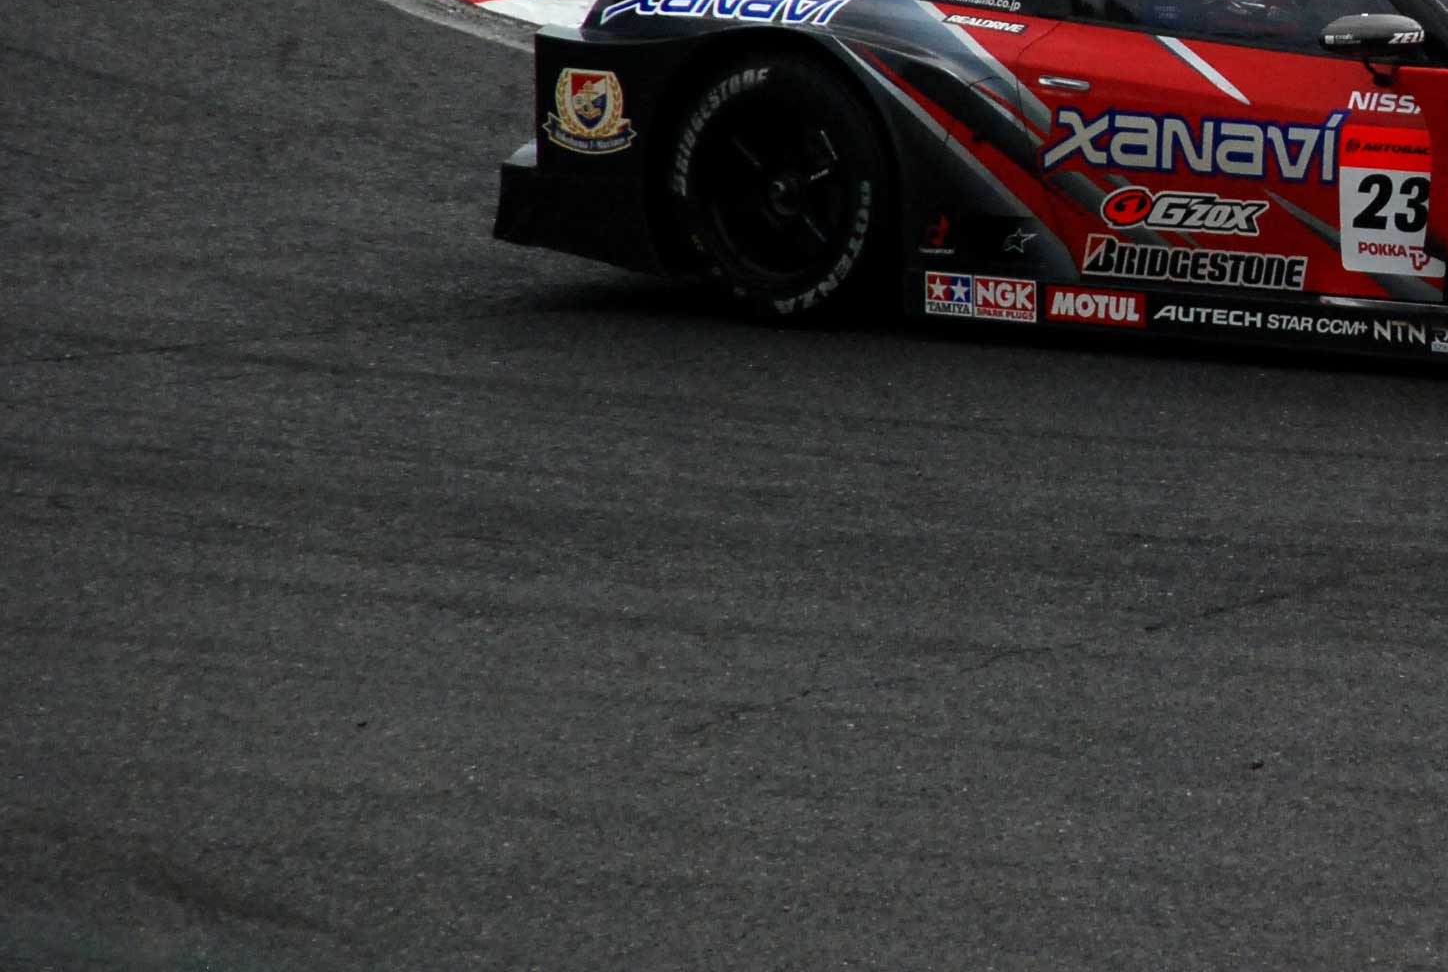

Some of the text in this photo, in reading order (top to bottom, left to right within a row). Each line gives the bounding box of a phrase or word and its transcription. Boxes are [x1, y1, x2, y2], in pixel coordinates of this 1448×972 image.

[945, 14, 1026, 34] REALDRIVE
[1347, 90, 1423, 115] NISS
[1351, 173, 1432, 234] 23
[1357, 240, 1408, 259] POKKA
[1085, 236, 1306, 289] BRIDGESTONE
[927, 301, 970, 315] TAMIYA
[975, 280, 1034, 311] NGK
[1049, 291, 1141, 323] MOTUL
[976, 308, 1035, 321] SPARK PLUGS
[1153, 304, 1263, 329] AUTECH
[1266, 312, 1369, 337] STAR CCM+
[1373, 319, 1428, 346] NTN
